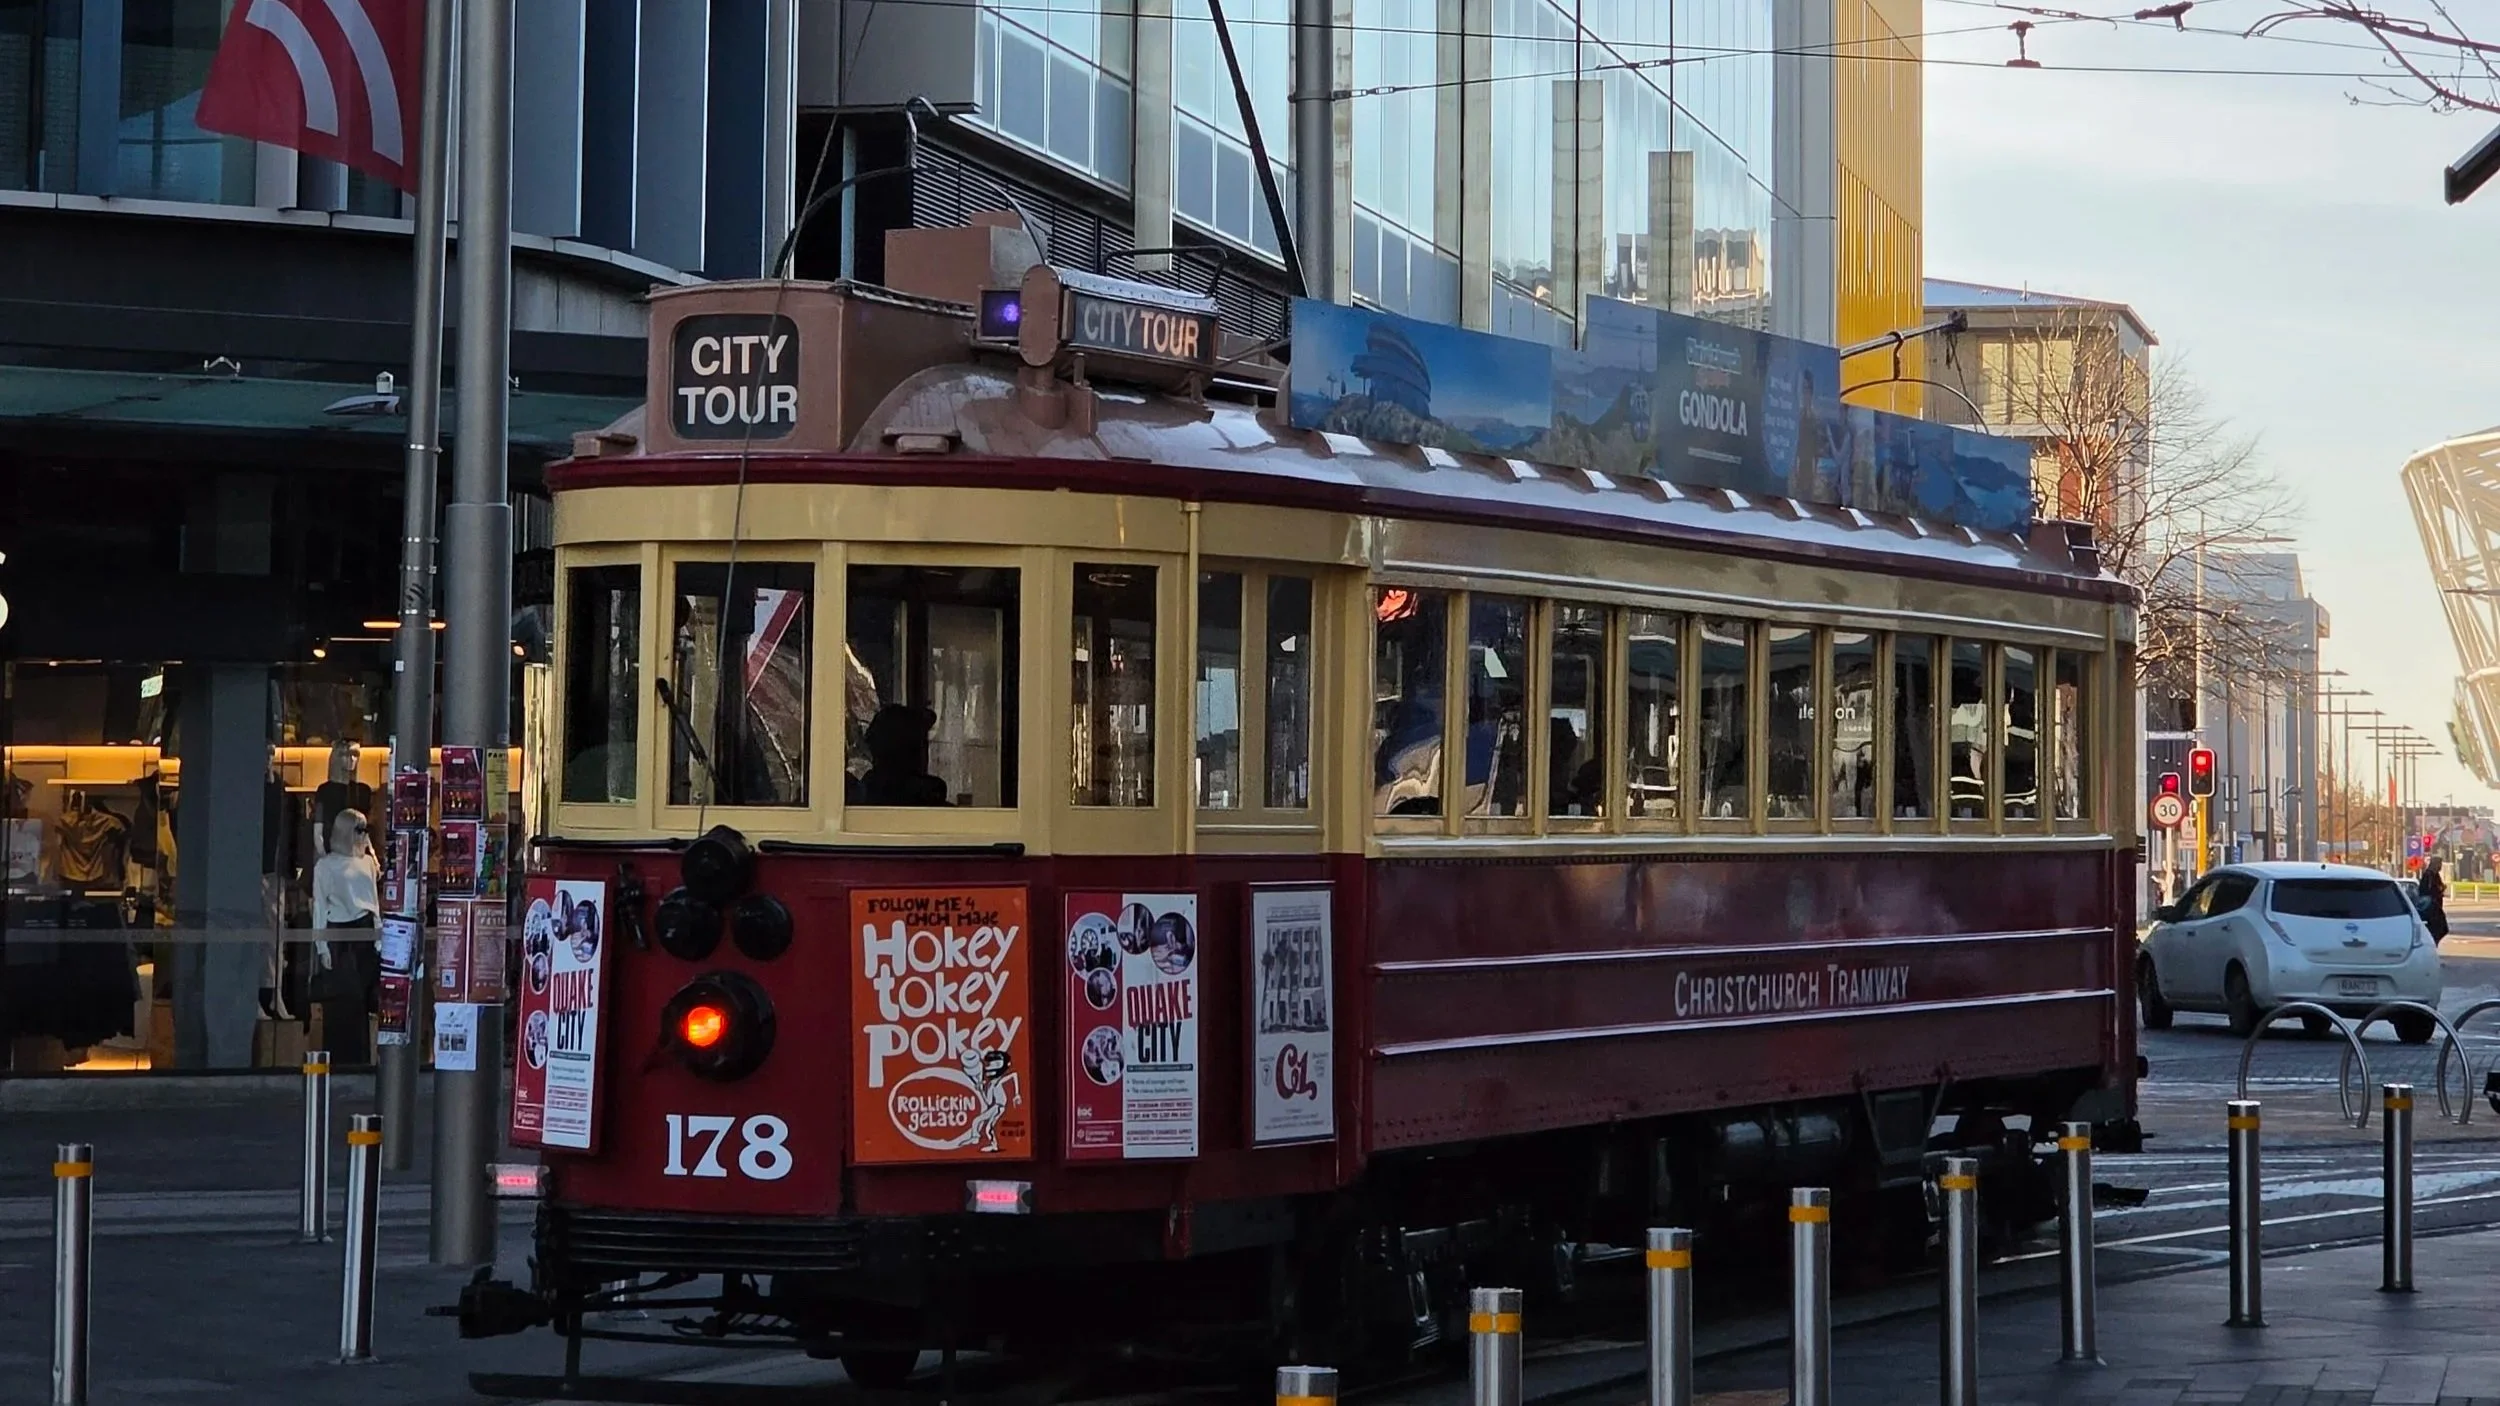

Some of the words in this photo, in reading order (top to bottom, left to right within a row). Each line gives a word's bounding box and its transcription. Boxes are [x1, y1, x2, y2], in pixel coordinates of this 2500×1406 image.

[1083, 301, 1136, 347] CITY
[1139, 310, 1200, 359] TOUR
[691, 334, 788, 376] CITY
[678, 385, 798, 425] TOUR
[1679, 389, 1748, 437] GONDOLA
[2159, 803, 2178, 817] 30
[867, 896, 930, 914] FOLLOW
[934, 896, 961, 913] ME
[862, 920, 1020, 979] Hokey
[553, 968, 595, 1014] QUAKE
[873, 963, 1010, 1022] tokey
[1126, 979, 1193, 1031] QUAKE
[1674, 971, 1820, 1017] CHRISTCHURCH
[1827, 963, 1910, 1006] TRAMWAY
[556, 1010, 586, 1051] CITY
[1137, 1021, 1183, 1063] CITY
[663, 1114, 793, 1180] 178
